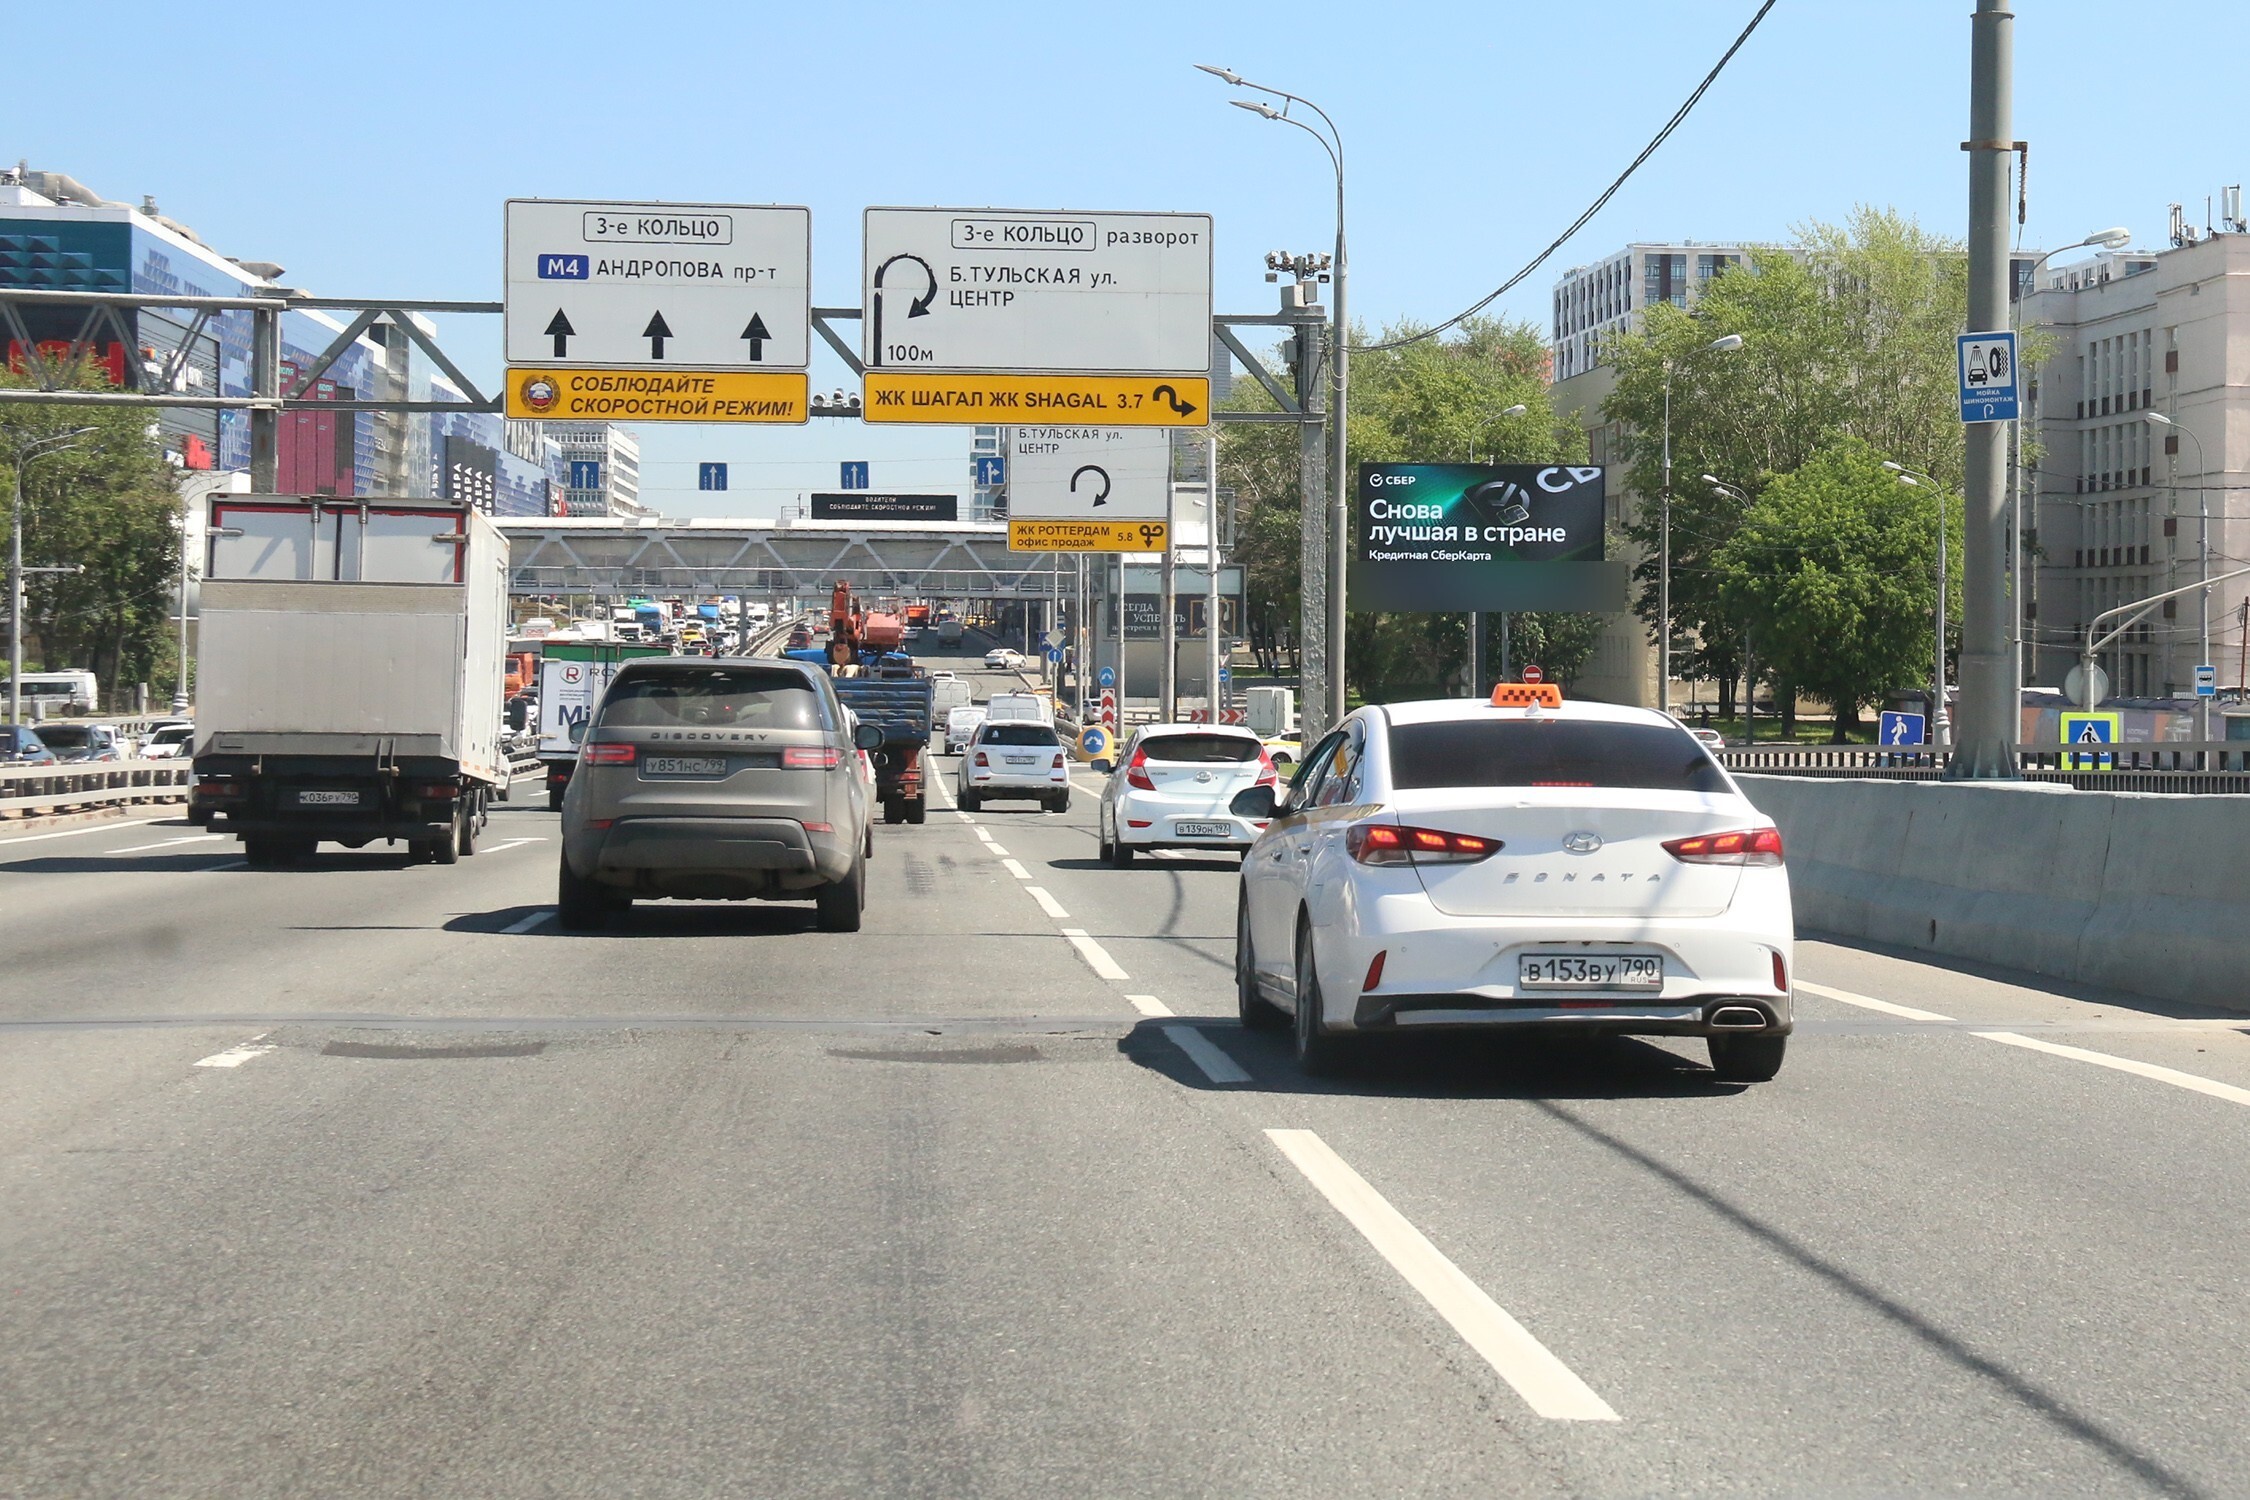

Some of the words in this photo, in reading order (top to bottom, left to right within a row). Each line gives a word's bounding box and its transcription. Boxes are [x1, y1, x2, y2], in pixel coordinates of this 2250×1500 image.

[596, 218, 628, 235] 3-е
[637, 219, 720, 239] КОЛЬЦО
[963, 225, 994, 242] 3-е
[1003, 226, 1084, 246] КОЛЬЦО
[1106, 231, 1199, 248] разворот
[547, 259, 579, 276] М4
[596, 259, 724, 279] АНДРОПОВА
[733, 265, 777, 283] пр-т
[949, 266, 1081, 284] Б.ТУЛЬСКАЯ
[1090, 271, 1118, 289] ул.
[949, 291, 1015, 308] ЦЕНТР
[887, 345, 934, 362] 100м
[570, 376, 715, 396] СОБЛЮДАЙТЕ
[569, 397, 710, 415] СКОРОСТНОЙ
[712, 400, 794, 417] РЕЖИМ!
[875, 390, 906, 406] ЖК
[911, 391, 983, 407] ШАГАЛ
[989, 392, 1020, 408] ЖК
[1024, 392, 1107, 409] SHAGAL
[1116, 393, 1144, 409] 3.7
[1963, 396, 2014, 405] ШИНОМОНТАЖ
[1019, 428, 1099, 440] Б.ТУЛЬСКАЯ
[1105, 431, 1123, 442] ул.
[1019, 443, 1060, 455] ЦЕНТР
[1385, 475, 1416, 485] СБЕР
[1369, 499, 1443, 520] Снова
[1017, 525, 1035, 535] ЖК
[1038, 526, 1110, 537] РОТТЕРДАМ
[1117, 532, 1134, 542] 5.8
[1369, 525, 1458, 545] лучшая
[1464, 526, 1478, 541] в
[1484, 526, 1566, 546] стране
[1017, 537, 1048, 548] офис
[1051, 539, 1095, 548] продаж
[1369, 550, 1428, 561] Кредитная
[1431, 550, 1492, 561] СберКарта
[651, 732, 769, 741] DISCOVERY
[1503, 872, 1661, 884] SONATA
[1630, 976, 1648, 984] RUS
